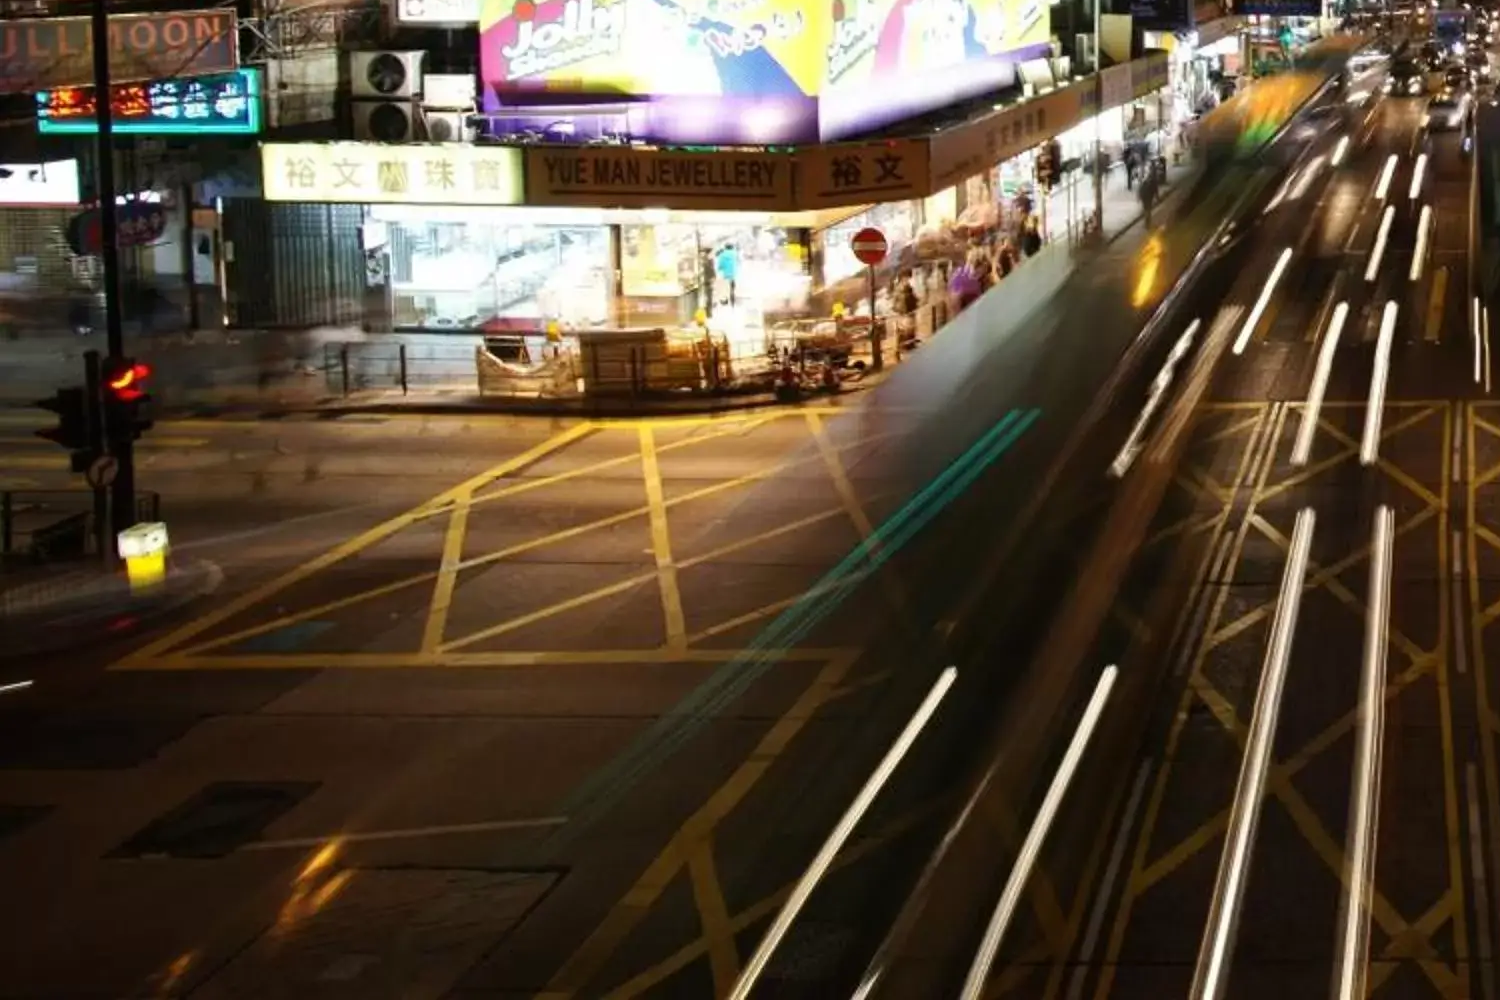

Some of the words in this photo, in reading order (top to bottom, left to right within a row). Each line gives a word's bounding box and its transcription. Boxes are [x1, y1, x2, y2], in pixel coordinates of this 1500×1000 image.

[545, 157, 588, 184] YUE
[594, 158, 641, 185] MAN
[646, 159, 778, 188] JEWELLERY
[831, 154, 904, 187] 裕文
